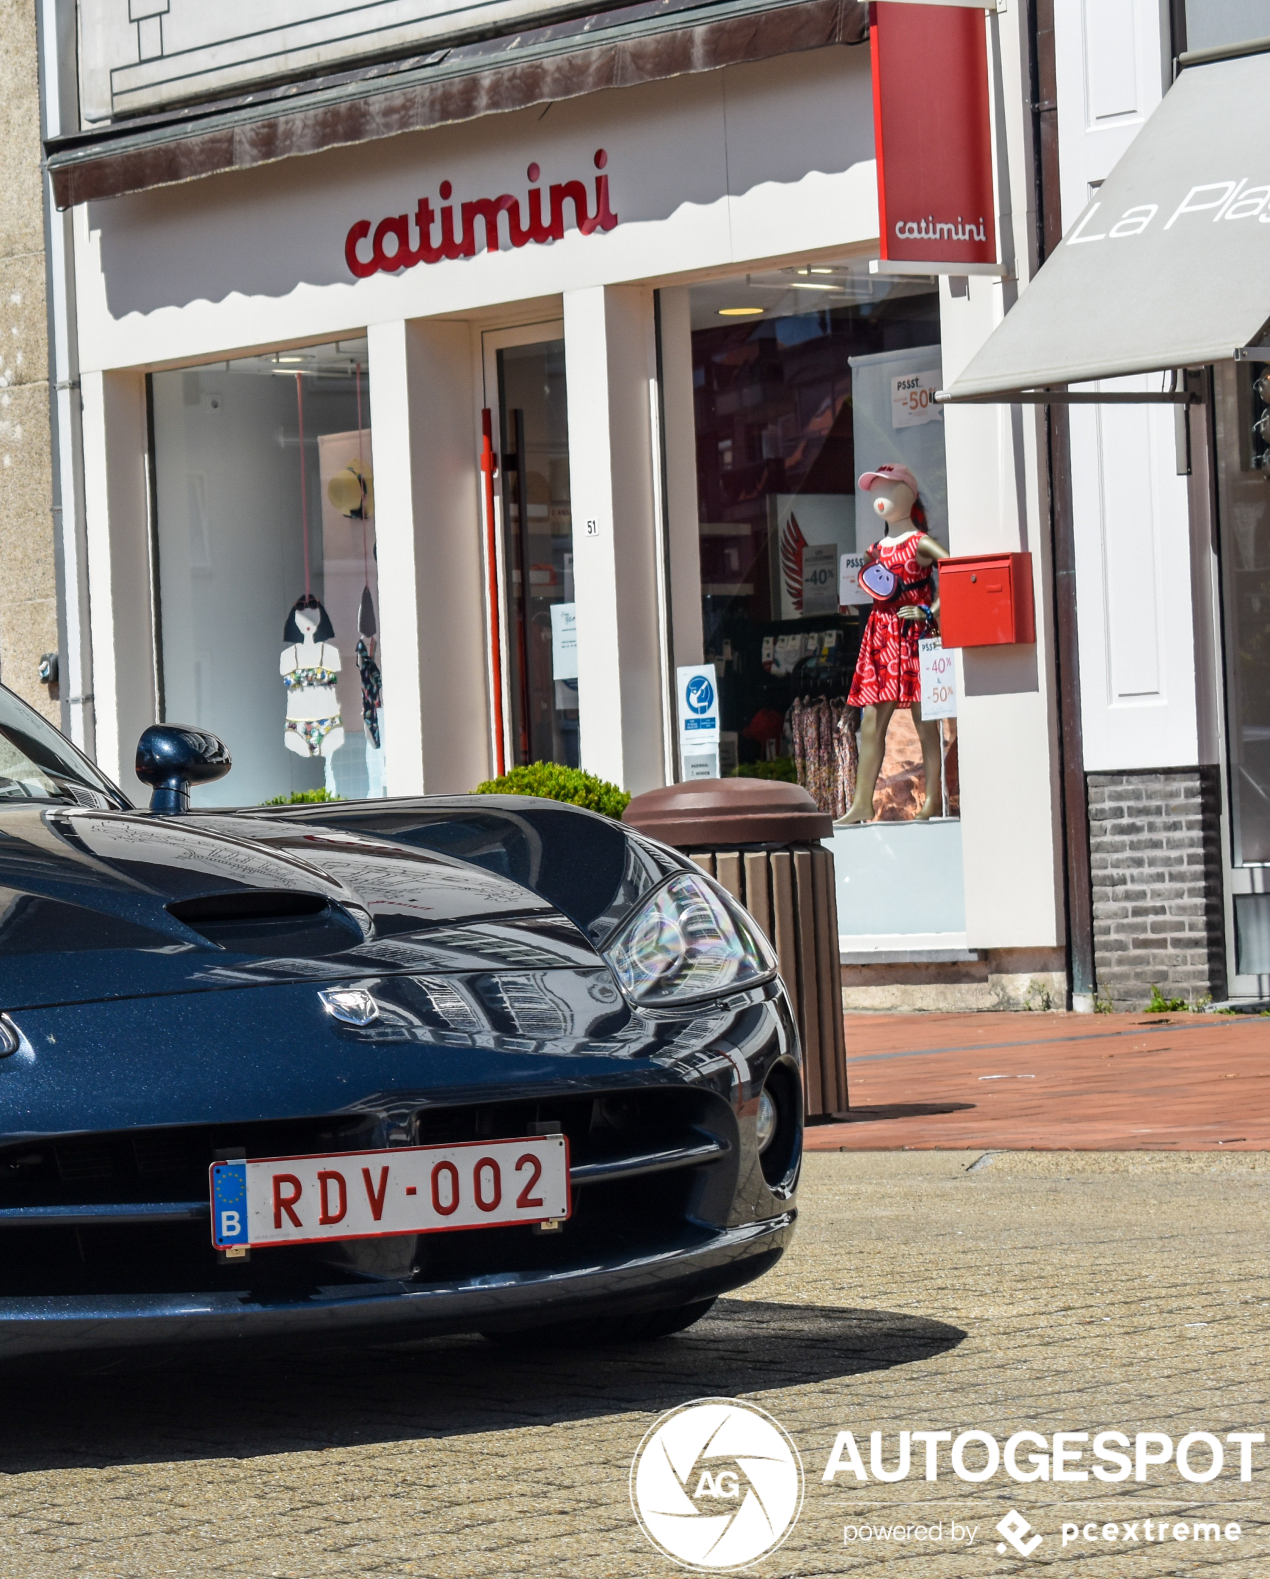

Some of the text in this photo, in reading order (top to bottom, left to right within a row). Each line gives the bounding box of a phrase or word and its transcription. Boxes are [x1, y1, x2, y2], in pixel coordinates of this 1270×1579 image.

[344, 148, 618, 278] catimini
[1065, 201, 1159, 246] La
[894, 215, 987, 242] catimini
[586, 519, 597, 535] 51
[846, 557, 864, 569] PSSS
[804, 568, 835, 586] -40%
[220, 1153, 544, 1237] B RDV-002
